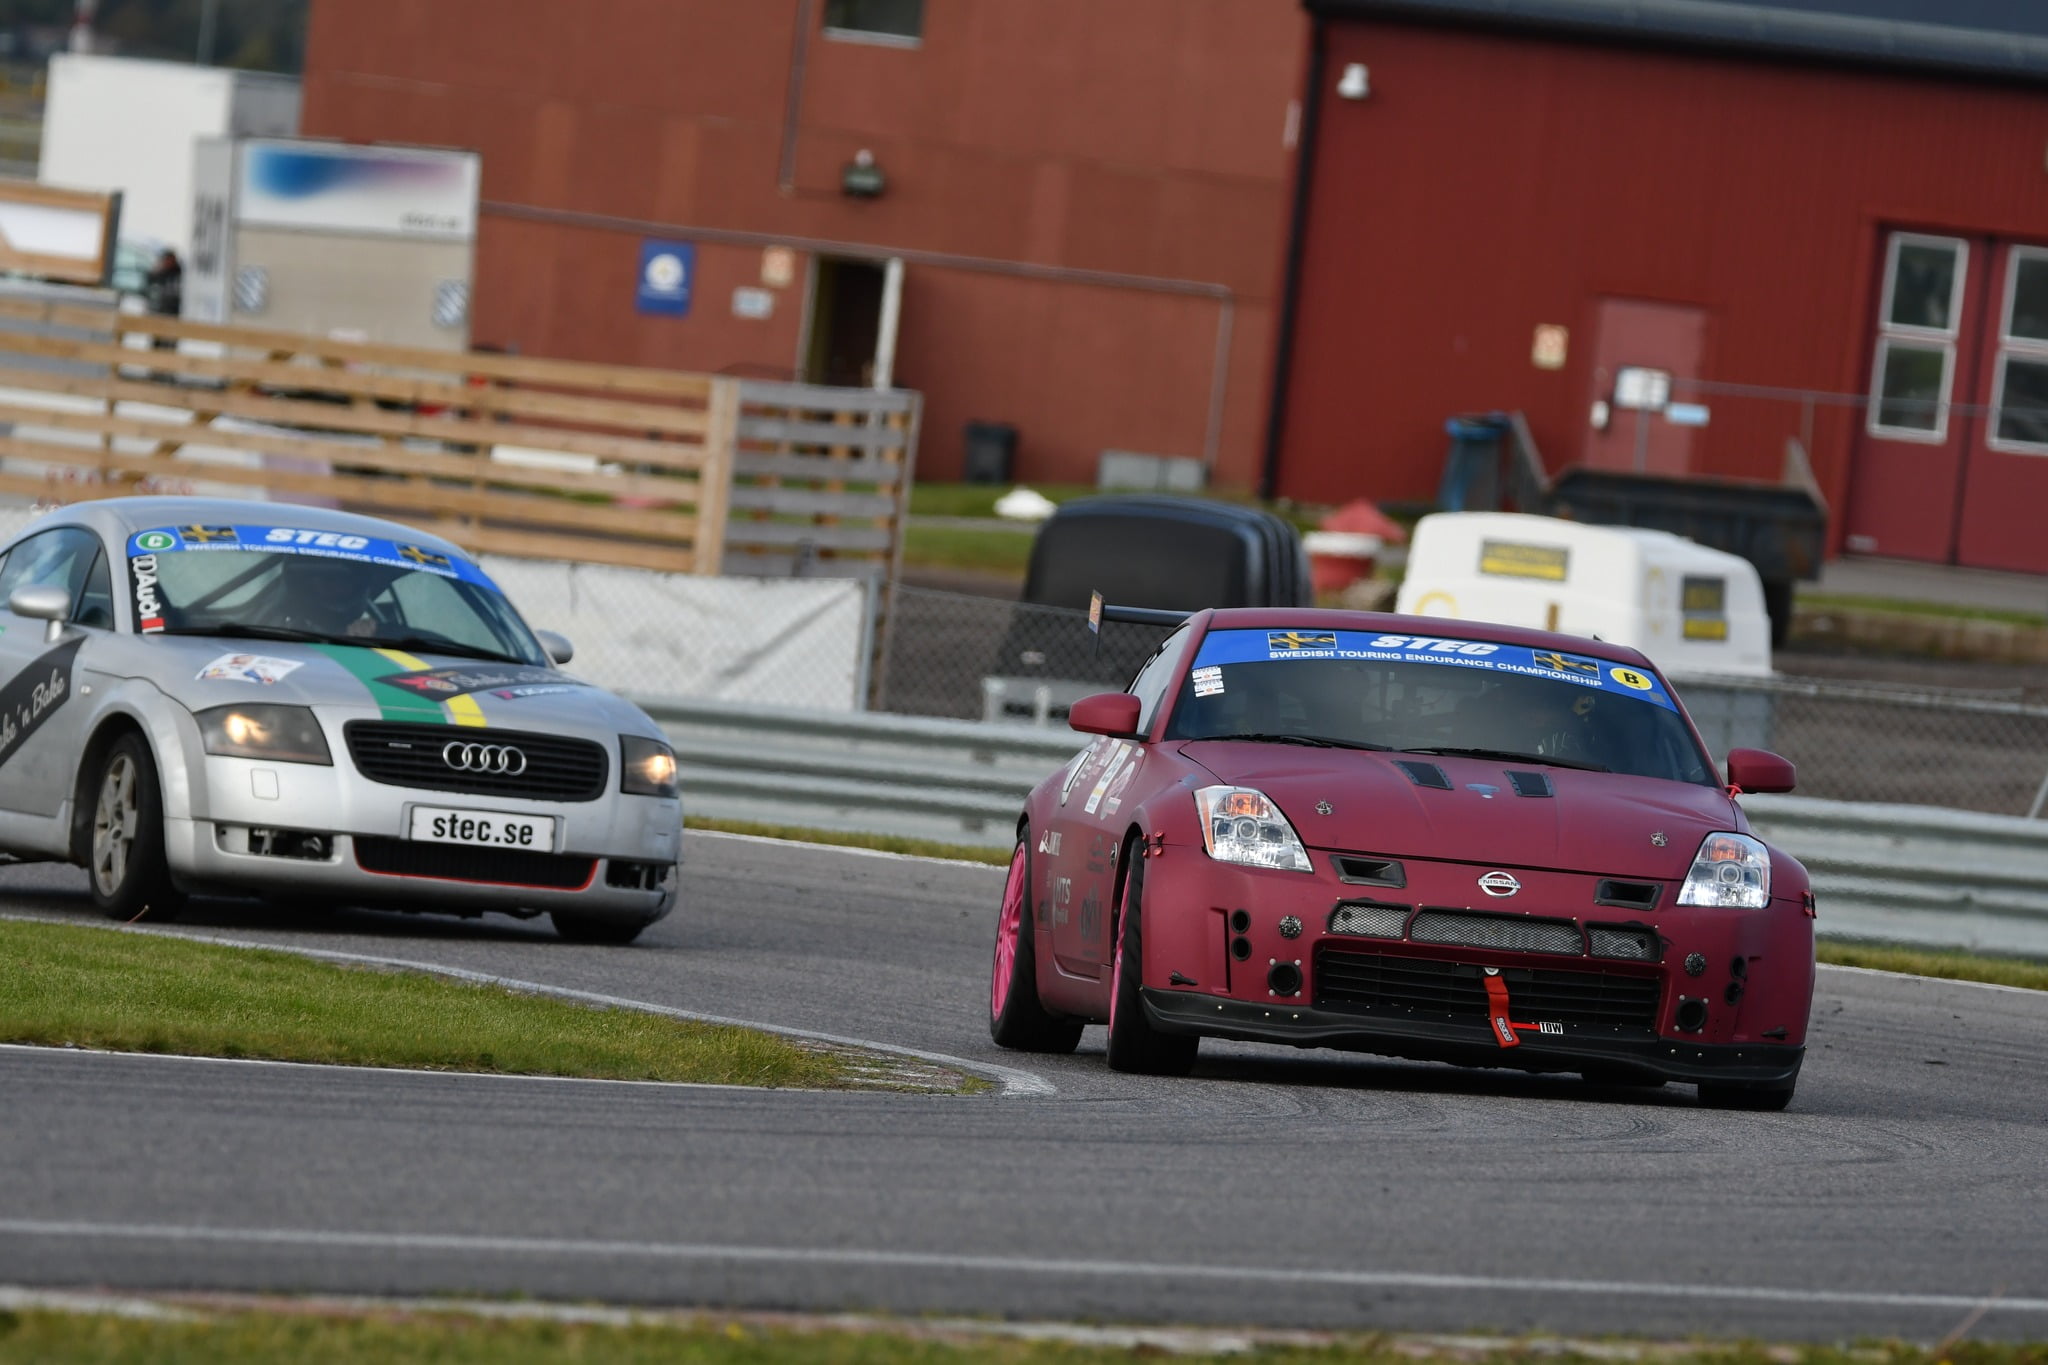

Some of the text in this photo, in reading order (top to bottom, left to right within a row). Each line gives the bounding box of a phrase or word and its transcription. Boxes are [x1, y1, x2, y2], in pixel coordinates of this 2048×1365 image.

[147, 535, 164, 548] C
[265, 527, 370, 550] STEC
[184, 543, 459, 578] SWEDISH TOURING ENDURANCE CHAMPIONSHIP
[1369, 635, 1500, 656] STEC
[1269, 650, 1603, 687] SWEDISH TOURING ENDURANCE CHAMPIONSHIP
[1623, 672, 1639, 685] B
[31, 667, 65, 719] Bake
[432, 813, 534, 846] stec.se
[1482, 879, 1518, 887] NISSAN
[1540, 1022, 1563, 1034] TOW
